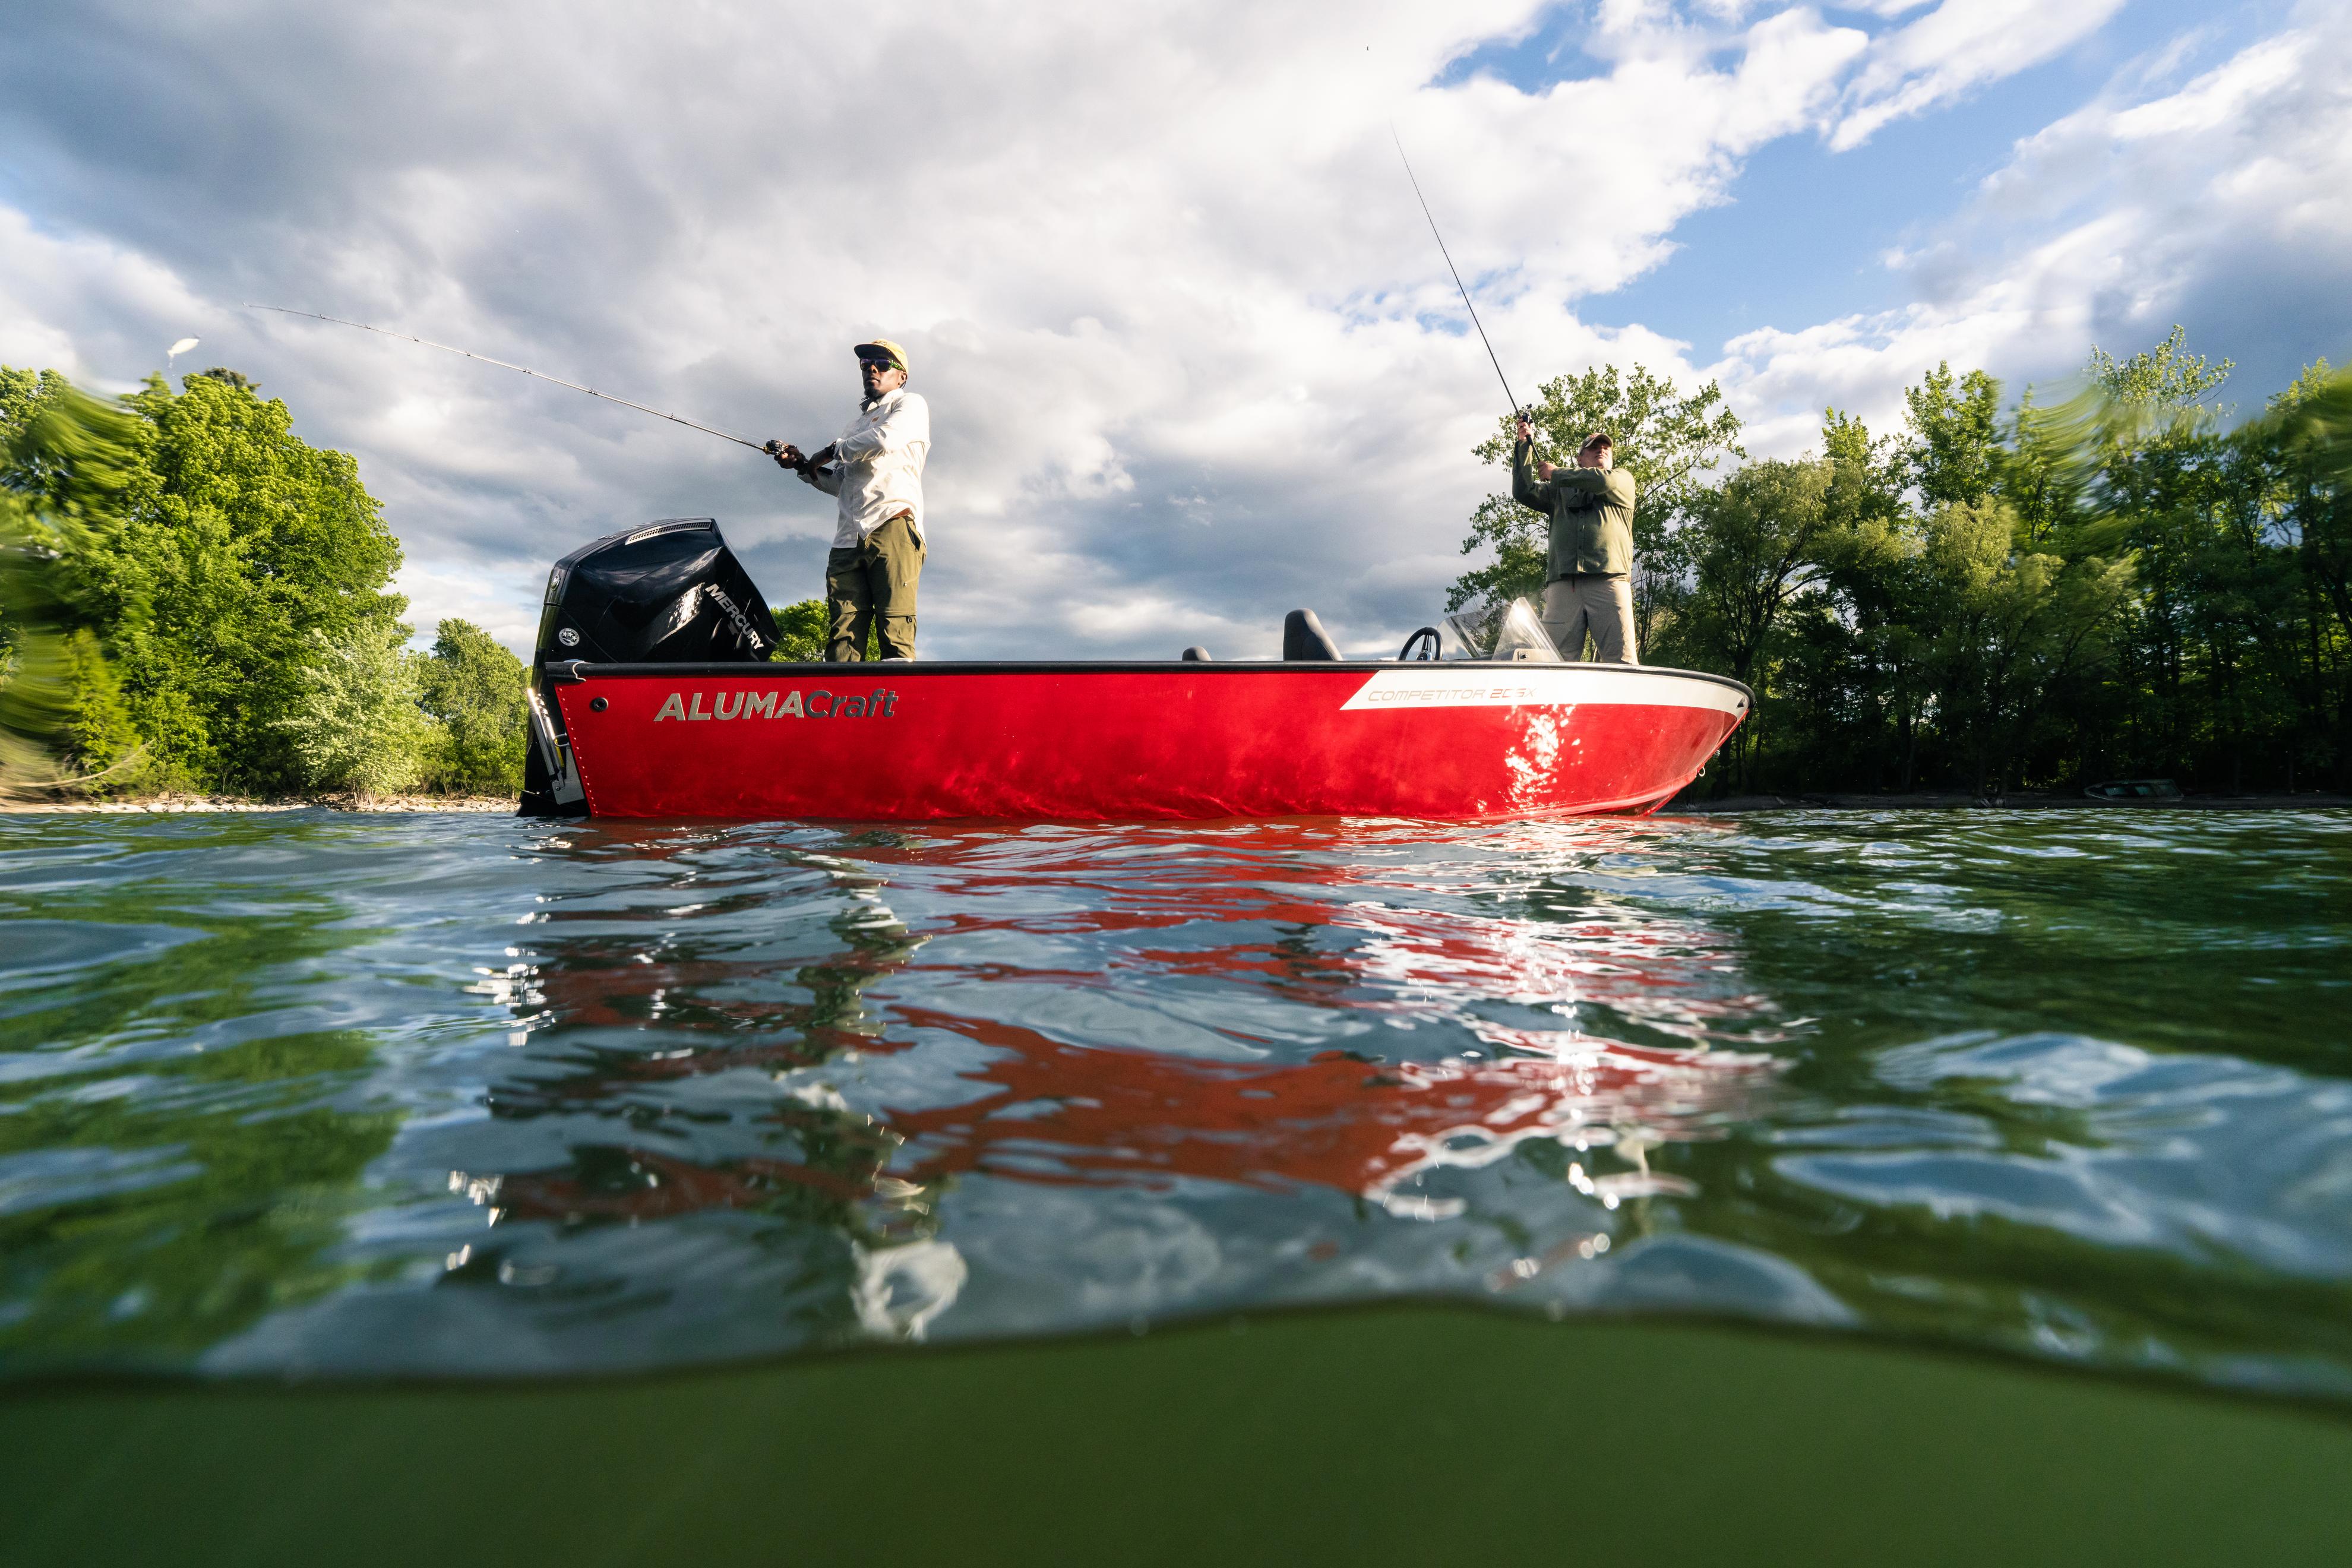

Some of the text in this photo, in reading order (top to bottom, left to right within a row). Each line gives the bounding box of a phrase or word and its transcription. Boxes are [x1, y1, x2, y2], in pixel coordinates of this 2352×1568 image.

[705, 583, 764, 650] MERCURY
[653, 688, 899, 722] ALUMACraft
[1368, 690, 1486, 701] COMPETITOR
